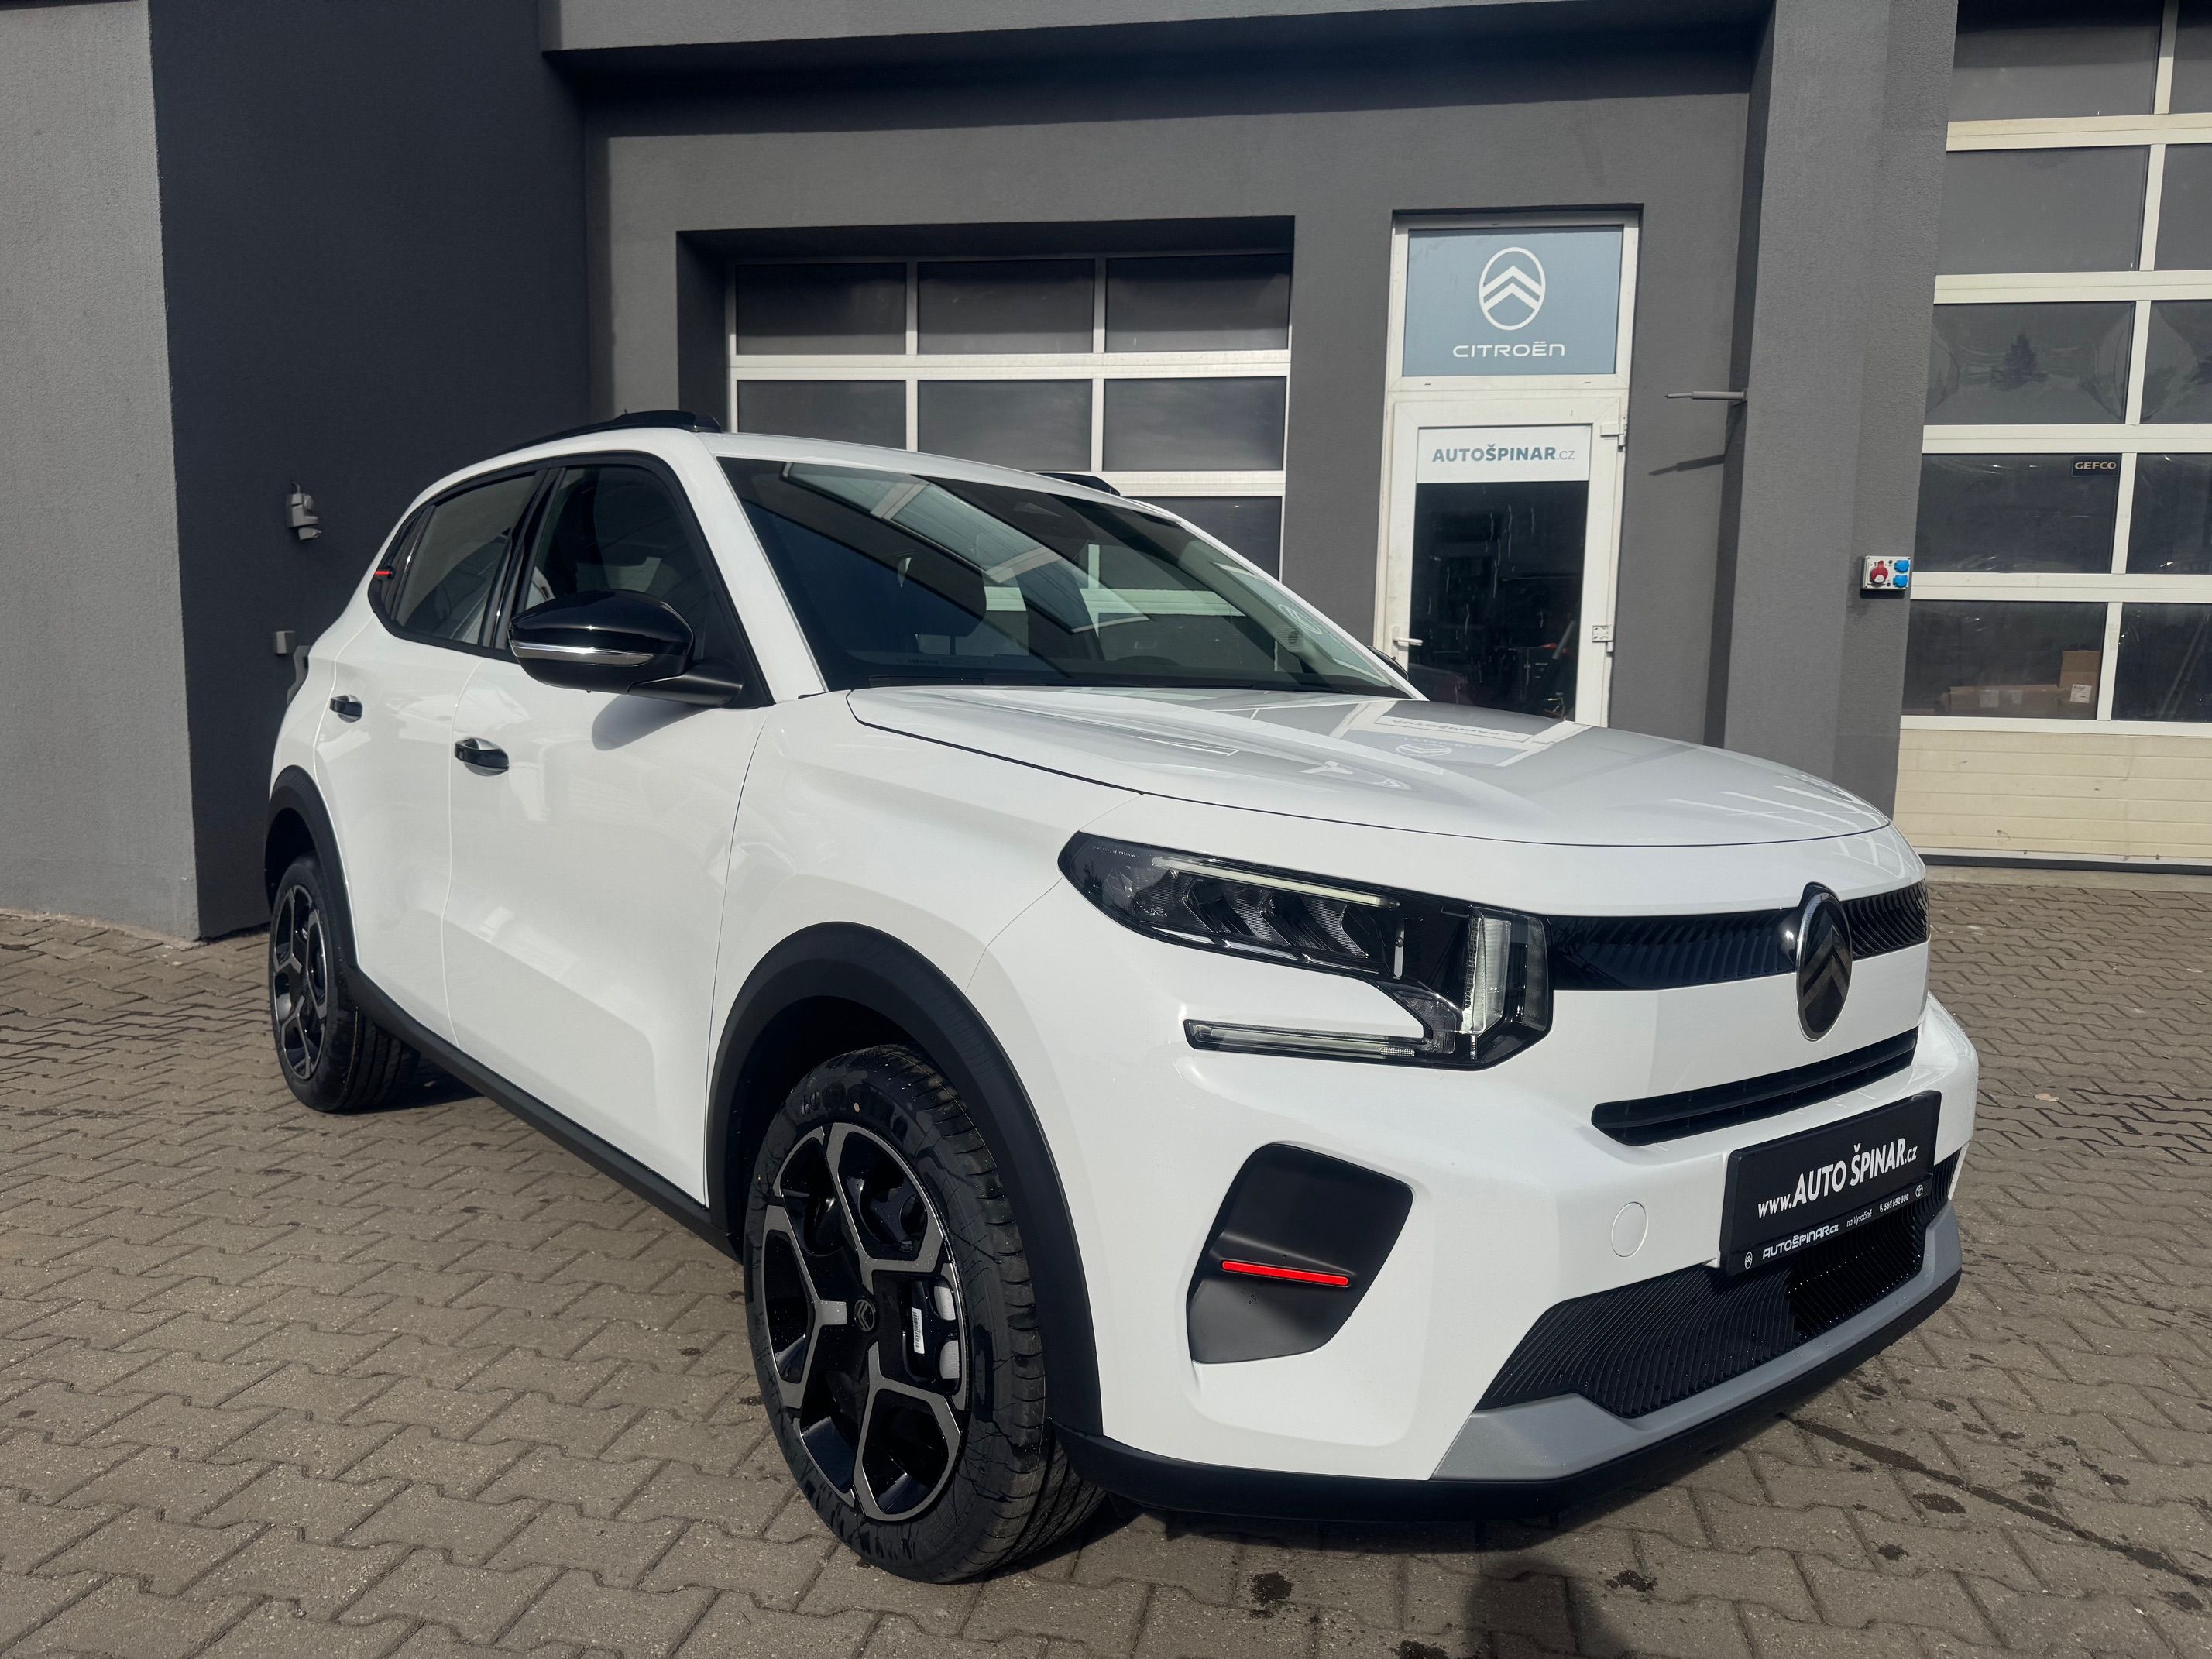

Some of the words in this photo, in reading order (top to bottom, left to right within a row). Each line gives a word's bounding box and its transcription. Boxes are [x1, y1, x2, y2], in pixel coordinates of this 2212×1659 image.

[1453, 341, 1565, 358] CITROËN
[2074, 462, 2117, 470] GEFCO
[1757, 1160, 1846, 1218] www.AUTO
[1850, 1138, 1918, 1187] ŠPINAR.cz
